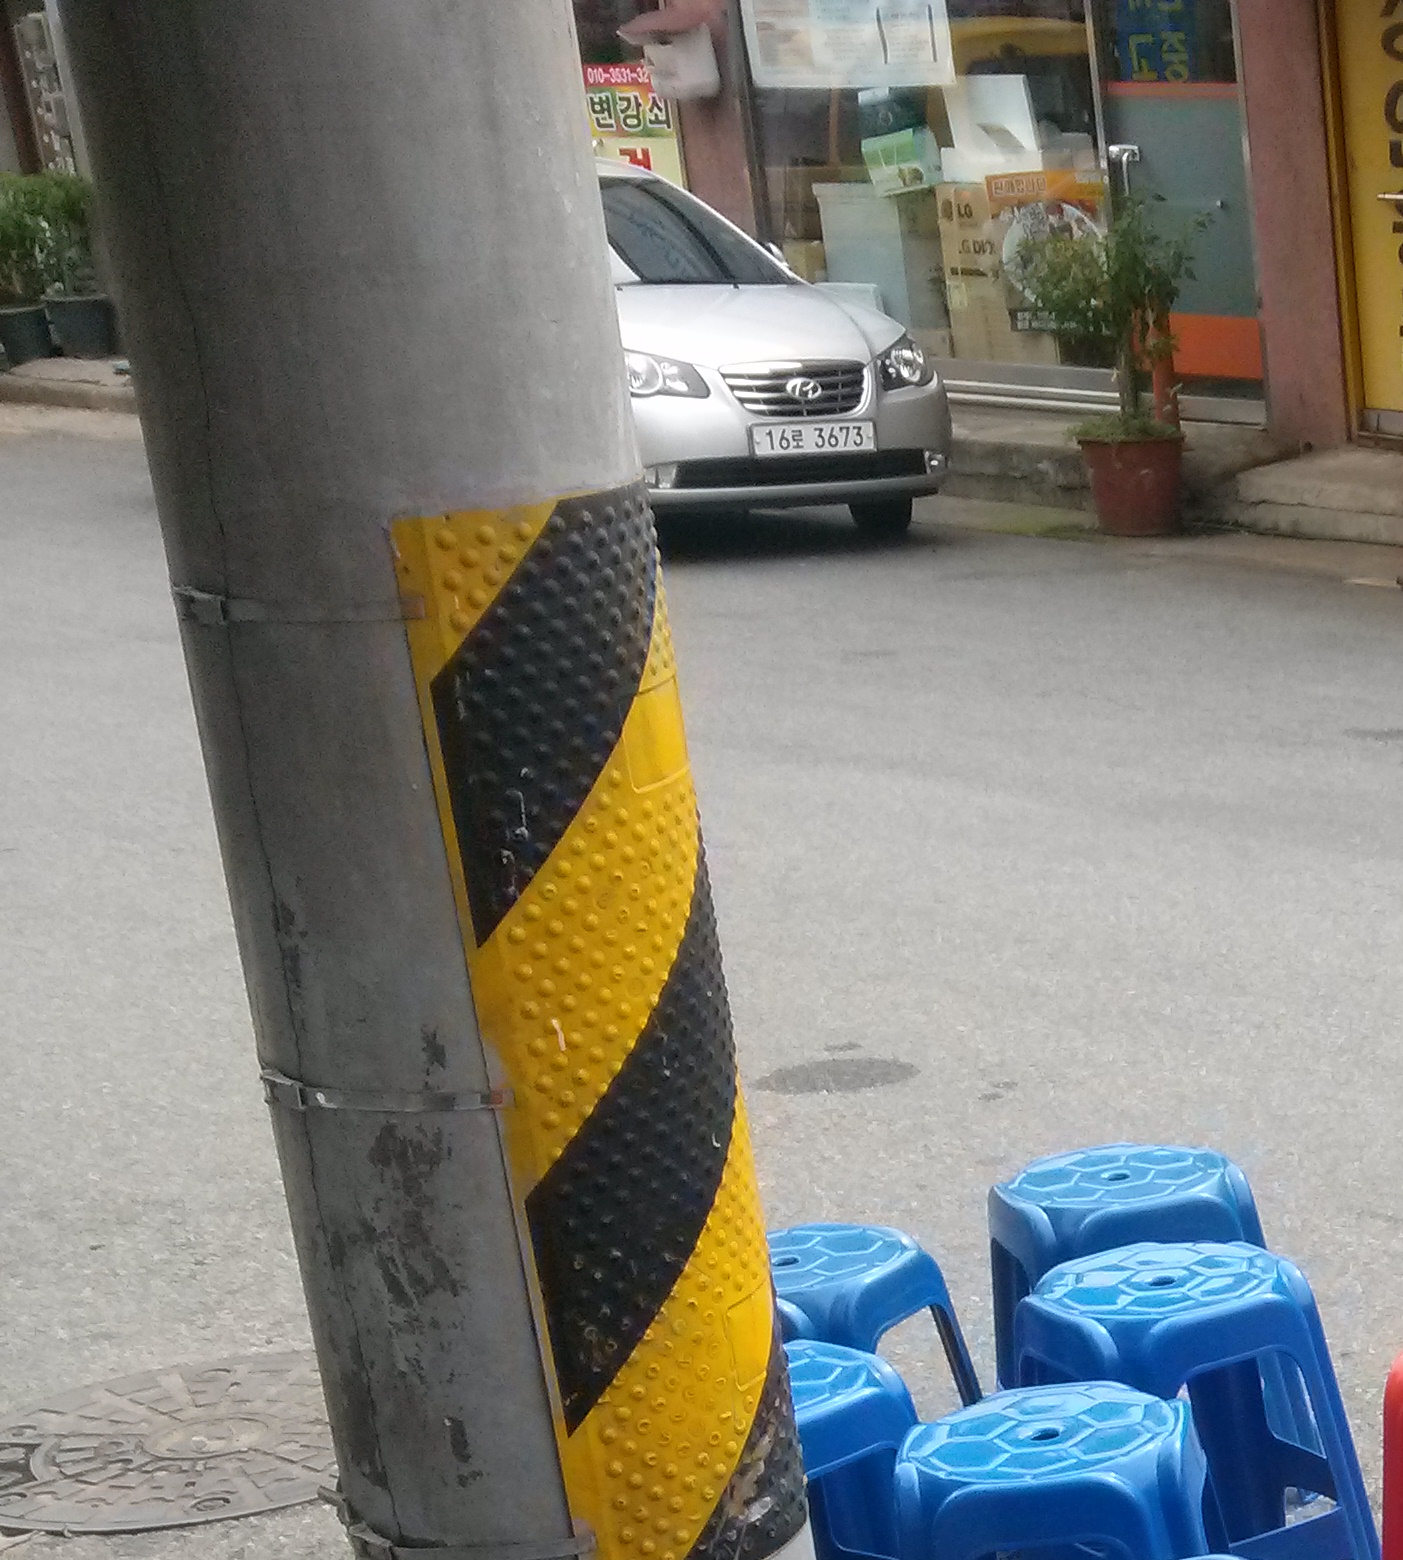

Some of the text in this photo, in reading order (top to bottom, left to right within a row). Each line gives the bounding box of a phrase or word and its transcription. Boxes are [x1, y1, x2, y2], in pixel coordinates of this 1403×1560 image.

[587, 92, 673, 131] 변강쇠
[957, 203, 973, 218] LG
[765, 426, 864, 451] 16로 3673
